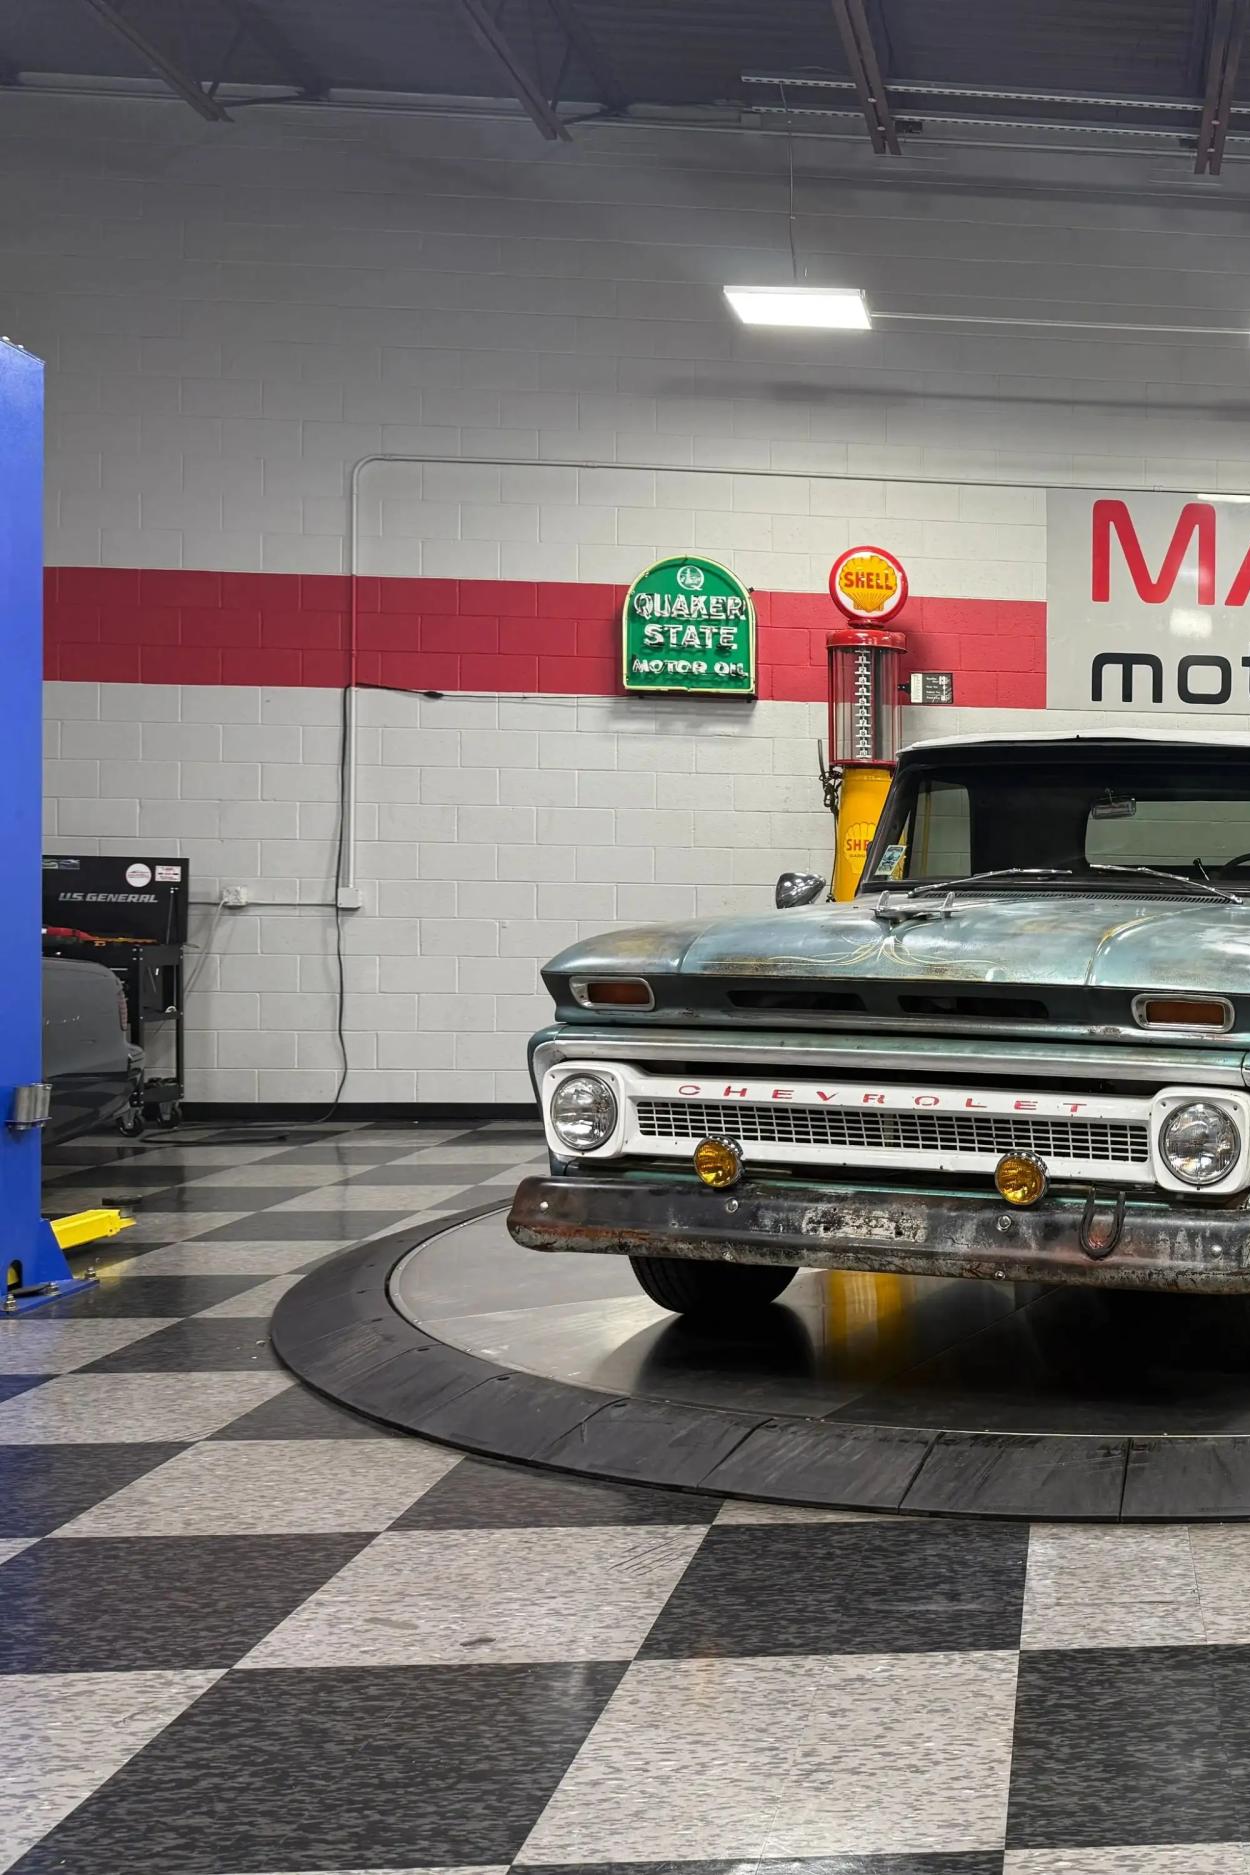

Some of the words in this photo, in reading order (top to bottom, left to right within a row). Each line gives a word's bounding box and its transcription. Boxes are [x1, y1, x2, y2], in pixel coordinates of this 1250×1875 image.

[843, 570, 894, 592] SHELL
[633, 593, 747, 621] QUAKER
[643, 624, 738, 650] STATE
[632, 658, 708, 675] MOTOR
[714, 660, 749, 678] OIL
[846, 838, 871, 851] SHE
[85, 892, 159, 903] GENERAL
[678, 1083, 1087, 1114] CHEVROLET
